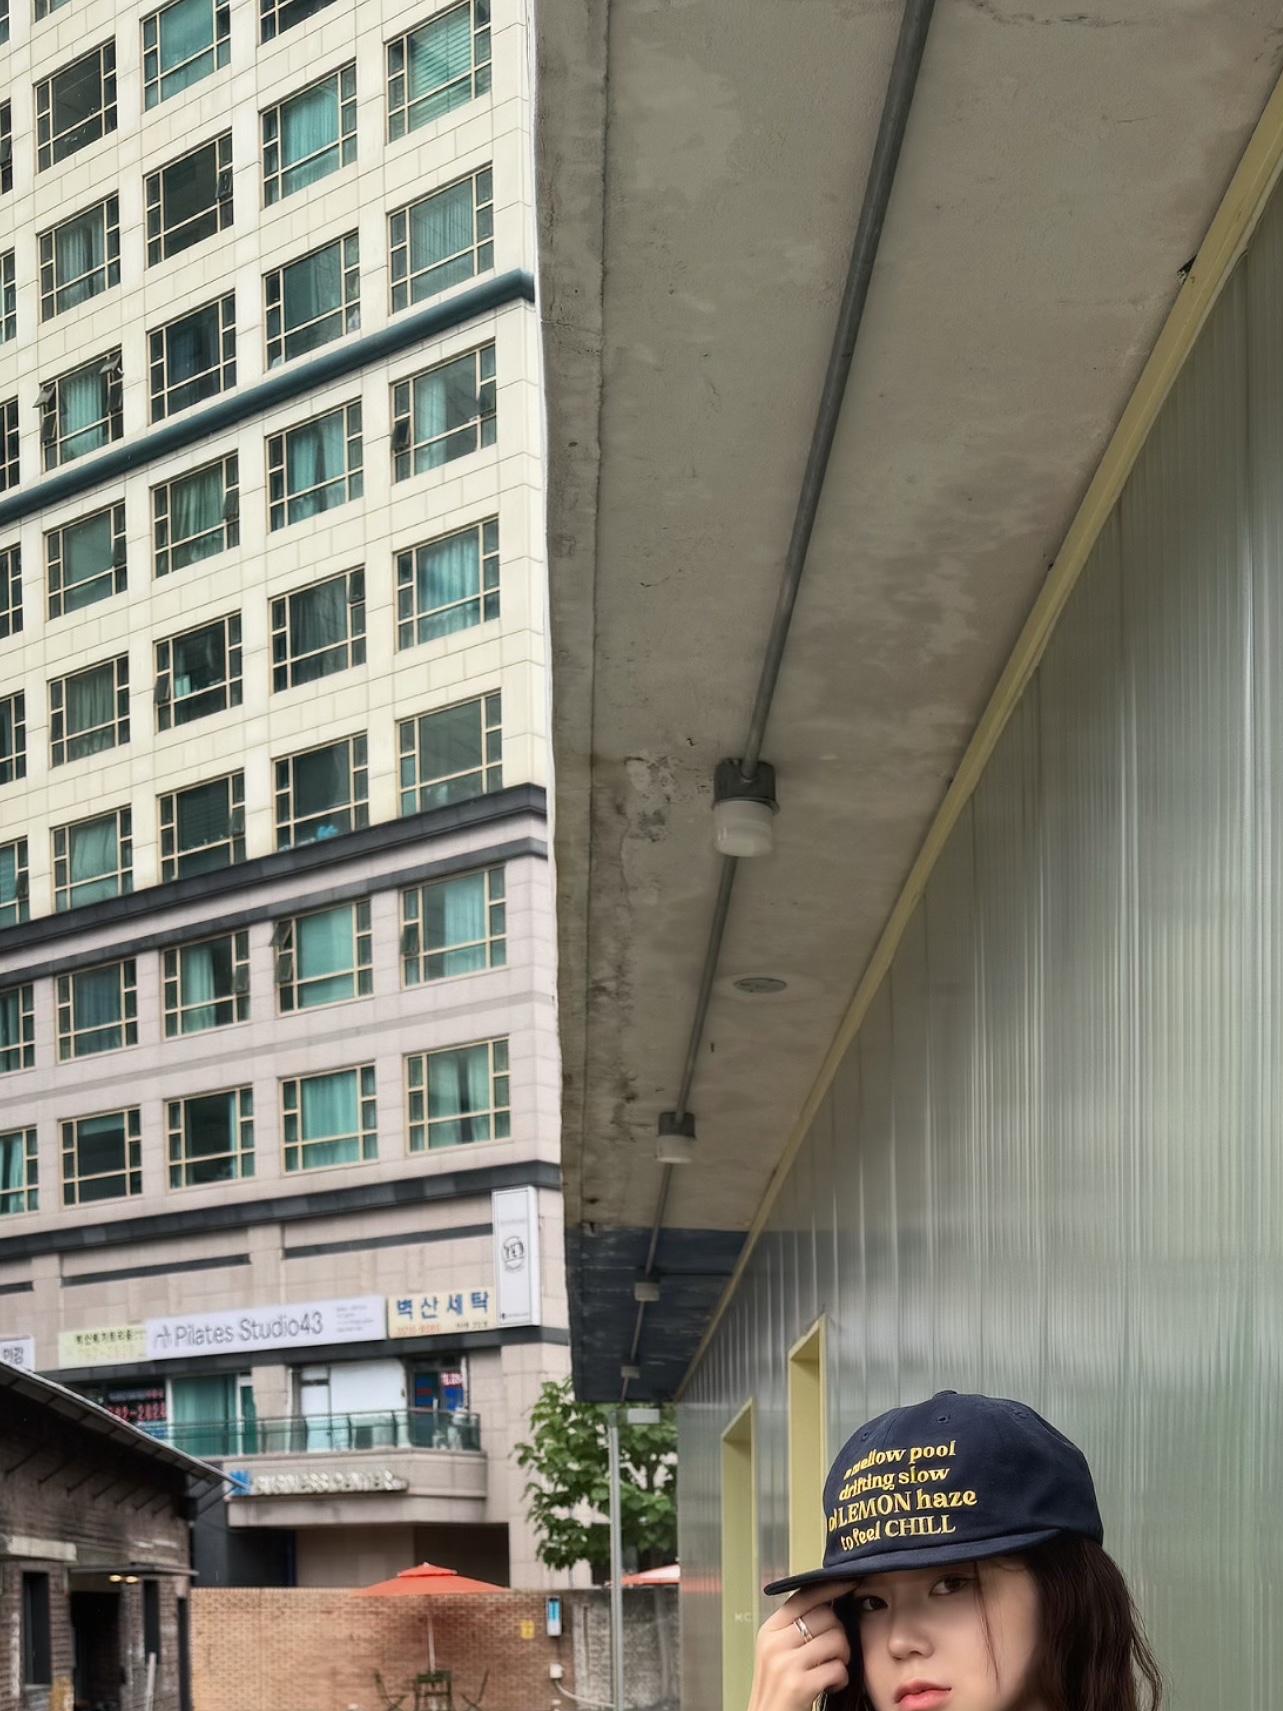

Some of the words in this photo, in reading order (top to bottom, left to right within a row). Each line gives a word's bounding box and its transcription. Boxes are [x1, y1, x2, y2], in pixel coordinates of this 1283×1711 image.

[395, 1290, 490, 1321] 벽산세탁
[174, 1323, 235, 1348] Pilates
[238, 1311, 323, 1342] Studio43
[850, 1448, 907, 1477] mellow
[908, 1439, 957, 1465] pool
[838, 1473, 896, 1502] drifting
[898, 1465, 951, 1484] slow
[837, 1490, 912, 1528] LEMON
[915, 1488, 978, 1511] haze
[840, 1535, 854, 1551] to
[852, 1520, 881, 1547] feel
[884, 1514, 956, 1538] CHILL
